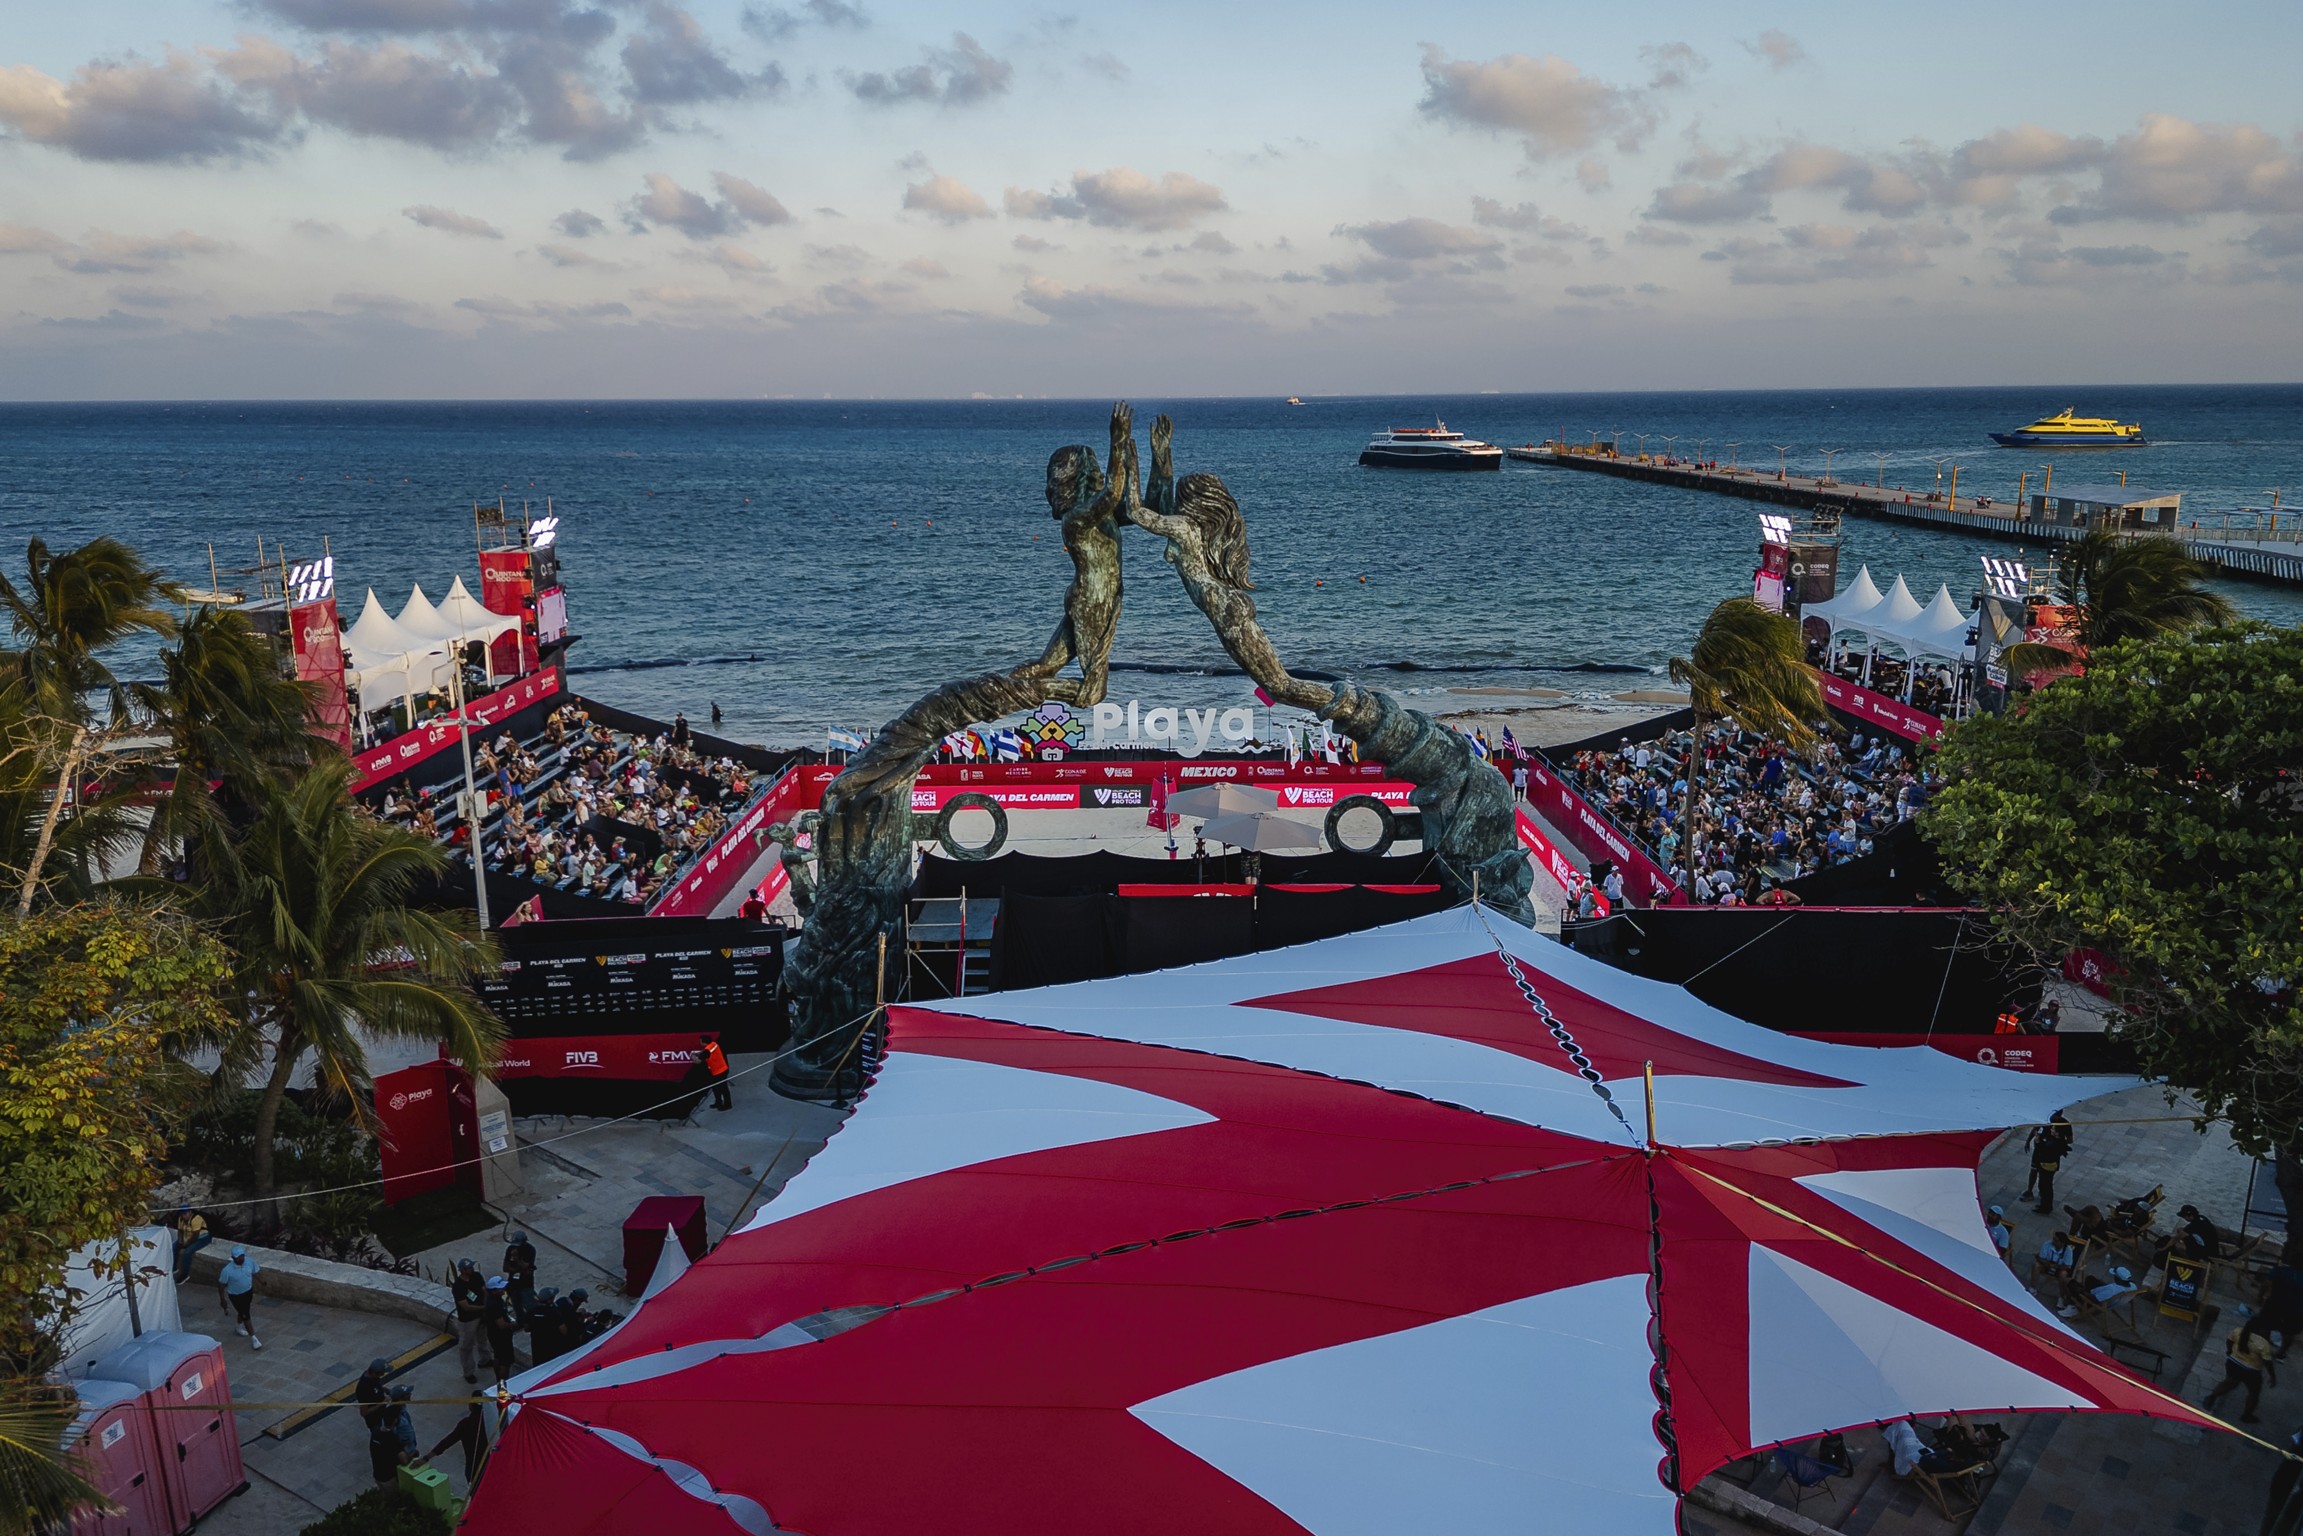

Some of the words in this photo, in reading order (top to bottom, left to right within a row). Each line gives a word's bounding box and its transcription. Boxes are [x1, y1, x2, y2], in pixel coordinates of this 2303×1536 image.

[1094, 700, 1254, 758] Playa
[1181, 766, 1237, 777] MEXICO
[912, 794, 936, 802] EACH
[1008, 794, 1029, 802] DEL
[1030, 793, 1075, 802] CARMEN
[566, 1052, 598, 1063] FIVB
[2005, 1050, 2032, 1058] CODEQ
[409, 1088, 433, 1101] Playa
[2169, 1279, 2195, 1291] BEACH
